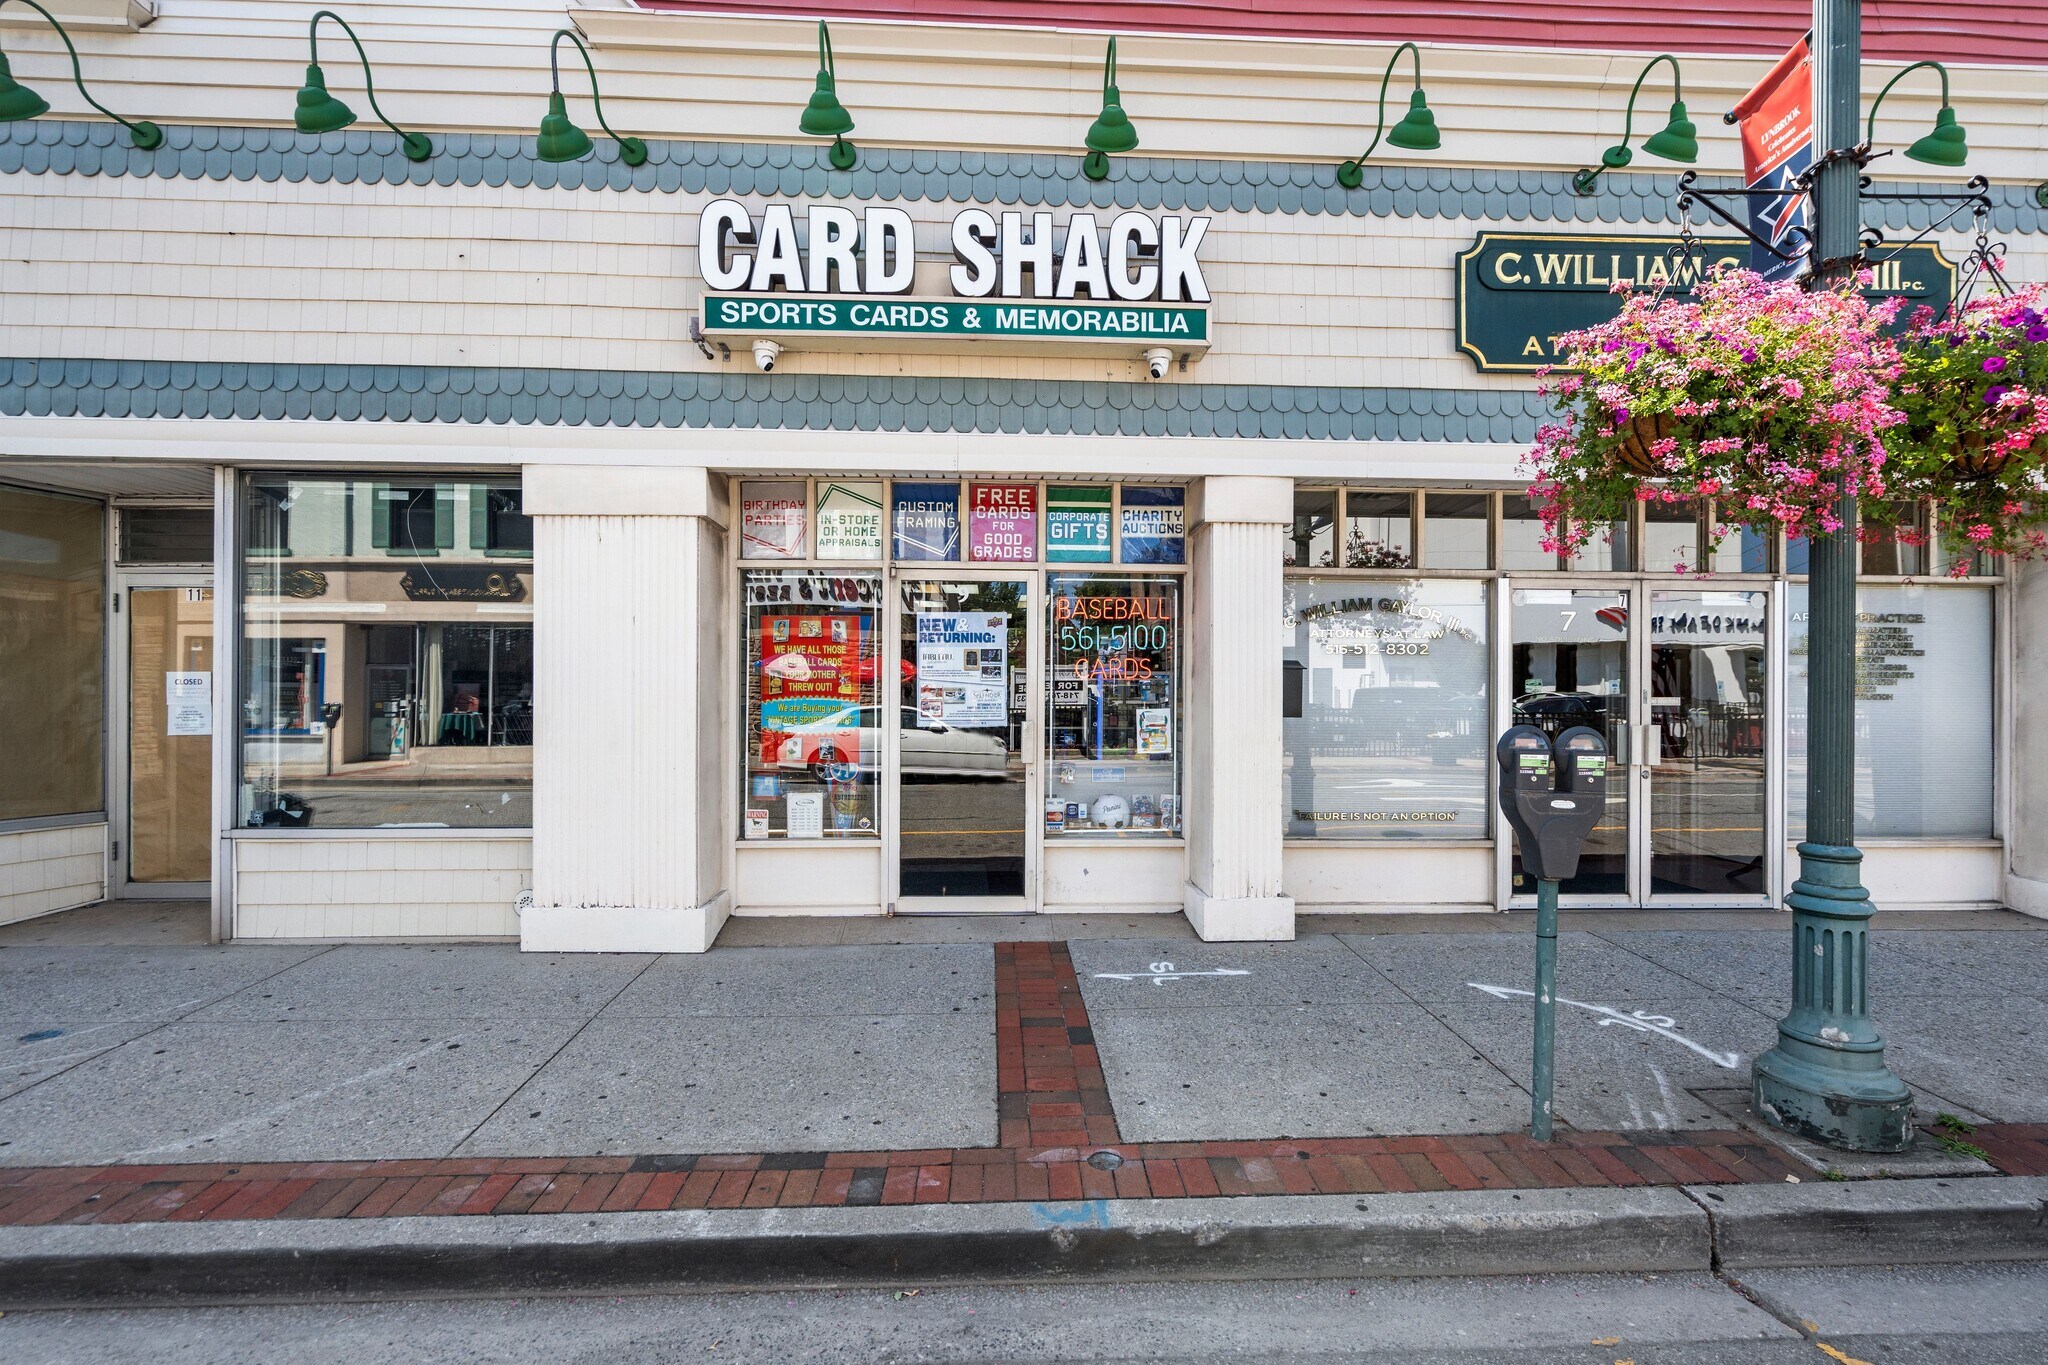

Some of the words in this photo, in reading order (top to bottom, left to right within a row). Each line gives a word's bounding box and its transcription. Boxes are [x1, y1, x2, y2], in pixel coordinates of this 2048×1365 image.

[1760, 104, 1802, 145] LYNBROOK
[1767, 126, 1797, 152] Celebrates
[698, 198, 917, 296] CARD
[949, 208, 1213, 302] SHACK
[1763, 261, 1786, 277] MERICA
[719, 301, 837, 325] SPORTS
[850, 304, 949, 328] CARDS
[962, 307, 983, 328] &
[996, 307, 1190, 334] MEMORABILIA
[976, 488, 1031, 505] FREE
[743, 500, 806, 511] BIRTHDAY
[898, 501, 954, 513] CUSTOM
[976, 505, 1031, 519] CARDS
[1049, 512, 1110, 522] CORPORATE
[1122, 509, 1183, 522] CHARITY
[745, 514, 806, 526] PARTIES
[820, 514, 880, 525] IN-STORE
[896, 516, 955, 528] FRAMING
[823, 526, 839, 537] OR
[844, 526, 877, 537] HOME
[992, 521, 1014, 531] FOR
[1051, 522, 1108, 539] GIFTS
[1122, 523, 1183, 534] AUCTIONS
[819, 538, 881, 547] APPRAISALS
[984, 533, 1023, 545] GOOD
[973, 546, 1033, 558] GRADES
[188, 588, 201, 601] 11
[1619, 594, 1626, 607] 7
[1056, 597, 1170, 621] BASEBALL
[1300, 598, 1373, 622] WILLIAM
[1377, 598, 1443, 624] GAYLOR
[919, 618, 957, 632] NEW
[956, 617, 969, 632] &
[1560, 611, 1577, 632] 7
[919, 632, 996, 643] RETURNING:
[1060, 624, 1167, 651] 561-5100
[1309, 629, 1390, 639] ATTORNEYS
[1394, 629, 1410, 639] AT
[1414, 629, 1445, 639] LAW
[774, 644, 786, 654] WE
[787, 645, 806, 654] HAVE
[807, 645, 821, 654] ALL
[823, 645, 847, 654] THOSE
[1325, 643, 1430, 656] 516-512-8302
[778, 658, 817, 667] BASEBALL
[818, 658, 843, 667] CARDS
[784, 670, 806, 679] YOUR
[808, 670, 836, 679] MOTHER
[1074, 658, 1153, 680] CARDS
[174, 678, 203, 686] CLOSED
[788, 682, 814, 692] THREW
[815, 682, 833, 692] OUT!
[778, 703, 788, 712] We
[790, 704, 800, 712] are
[802, 703, 826, 714] Buying
[827, 704, 843, 714] your
[1103, 803, 1121, 813] Panini
[746, 811, 768, 819] WARNING
[1350, 811, 1360, 821] IS
[1363, 811, 1388, 821] NOT
[1391, 811, 1408, 821] AN
